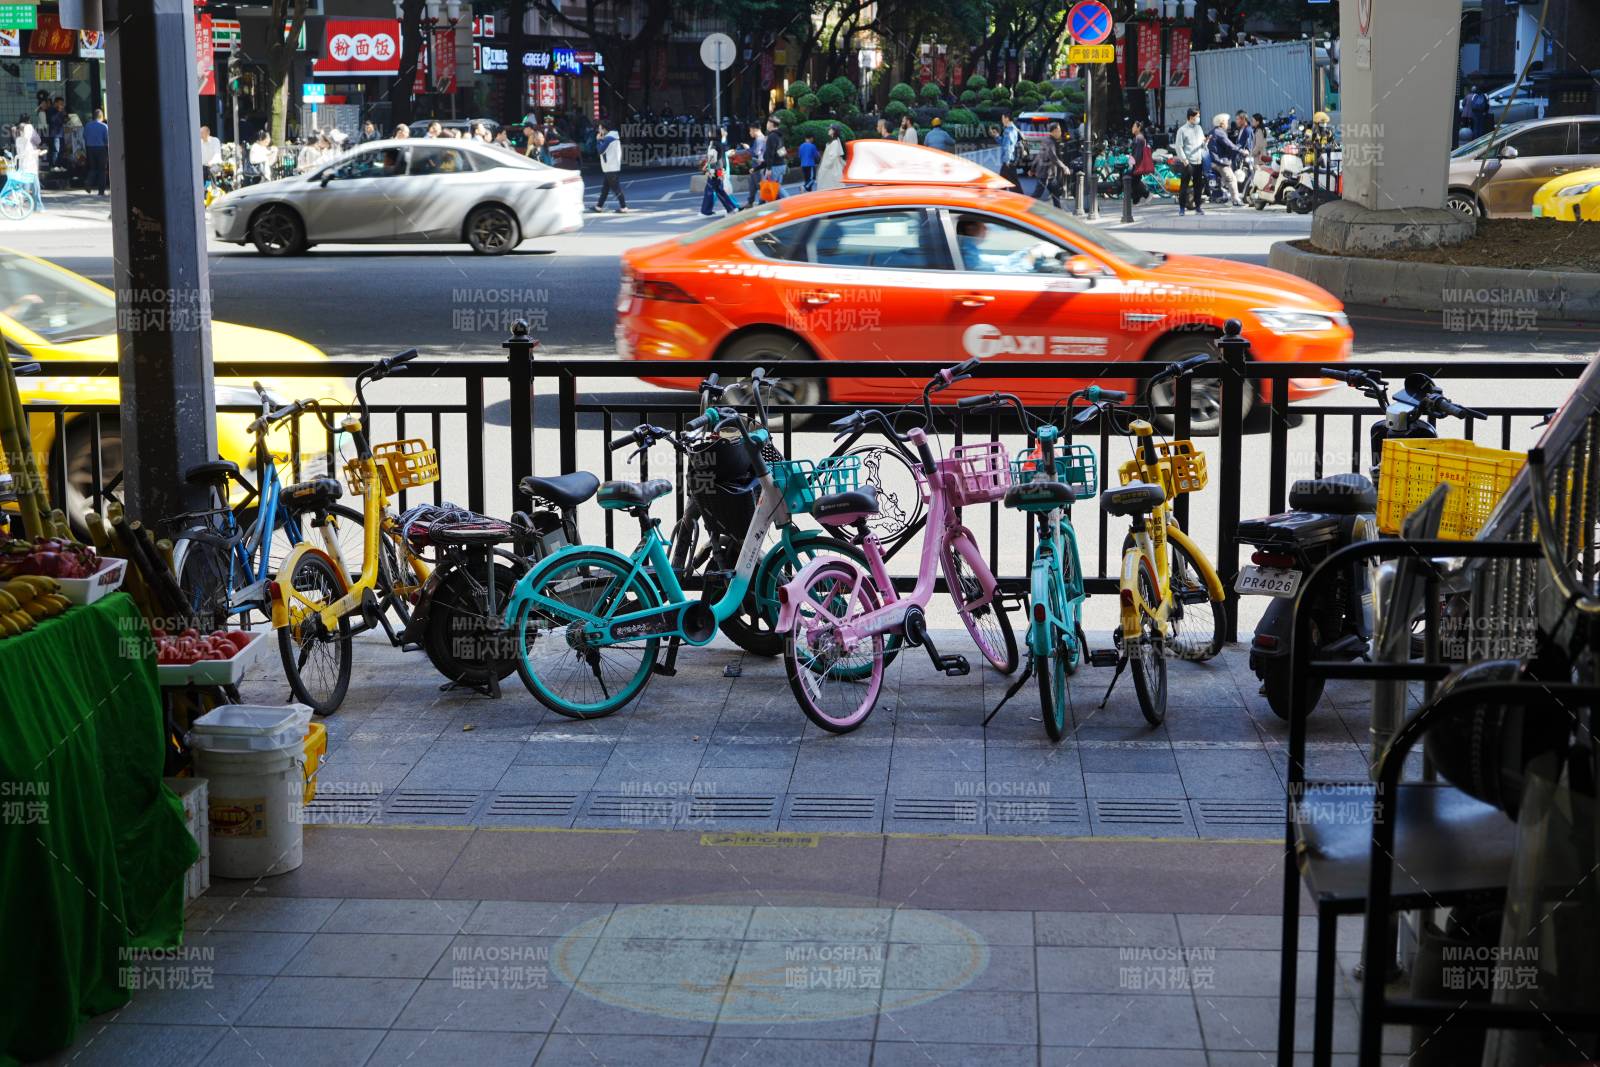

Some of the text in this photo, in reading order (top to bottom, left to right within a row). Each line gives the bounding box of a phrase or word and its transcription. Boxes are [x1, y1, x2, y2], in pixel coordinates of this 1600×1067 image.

[334, 37, 390, 57] 粉面饭
[1072, 48, 1110, 59] 严管路段
[1242, 577, 1292, 592] PR4026
